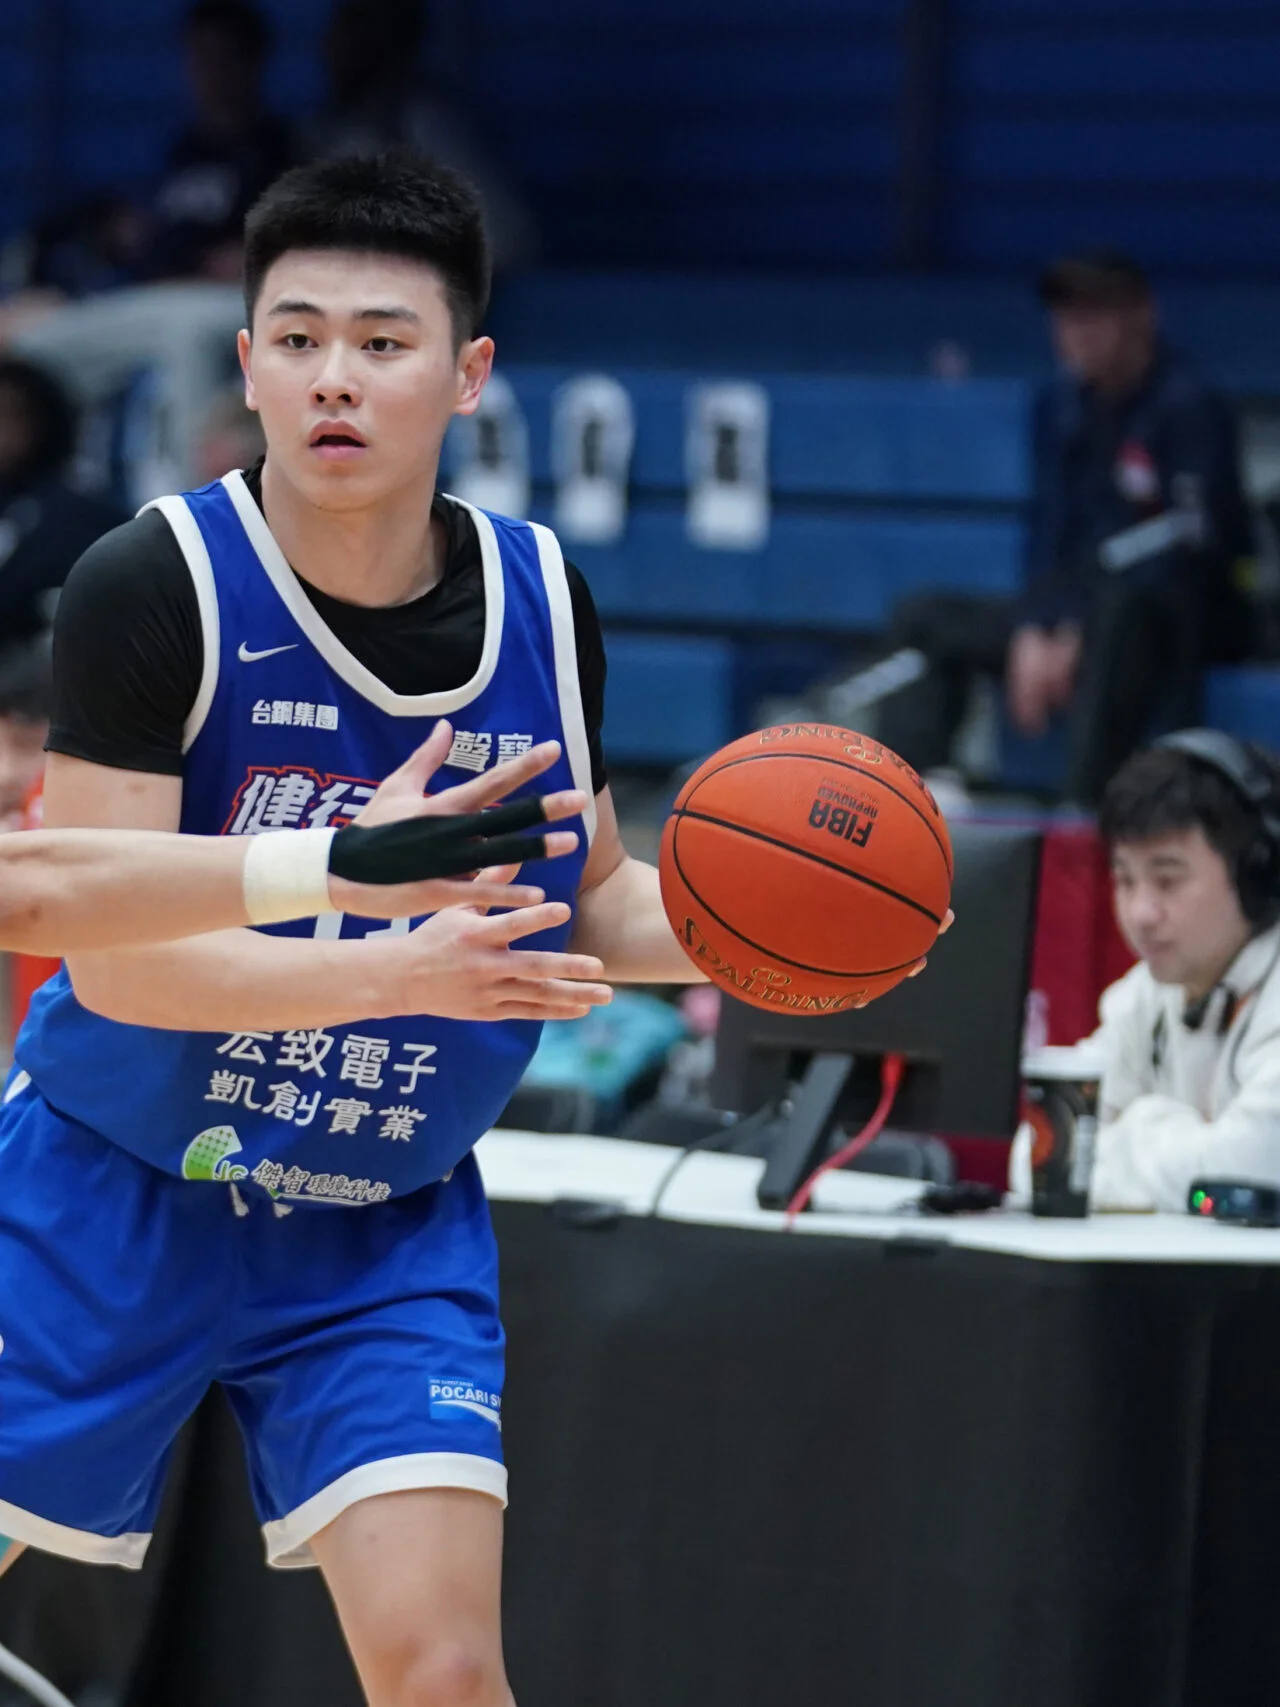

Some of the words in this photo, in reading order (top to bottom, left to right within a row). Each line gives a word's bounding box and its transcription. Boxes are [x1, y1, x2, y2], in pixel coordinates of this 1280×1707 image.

[251, 699, 339, 732] 台鋼集團
[817, 786, 878, 819] APPROVED
[808, 799, 873, 848] FIBA
[204, 1068, 428, 1142] 凱創實業
[430, 1384, 489, 1405] POCARI
